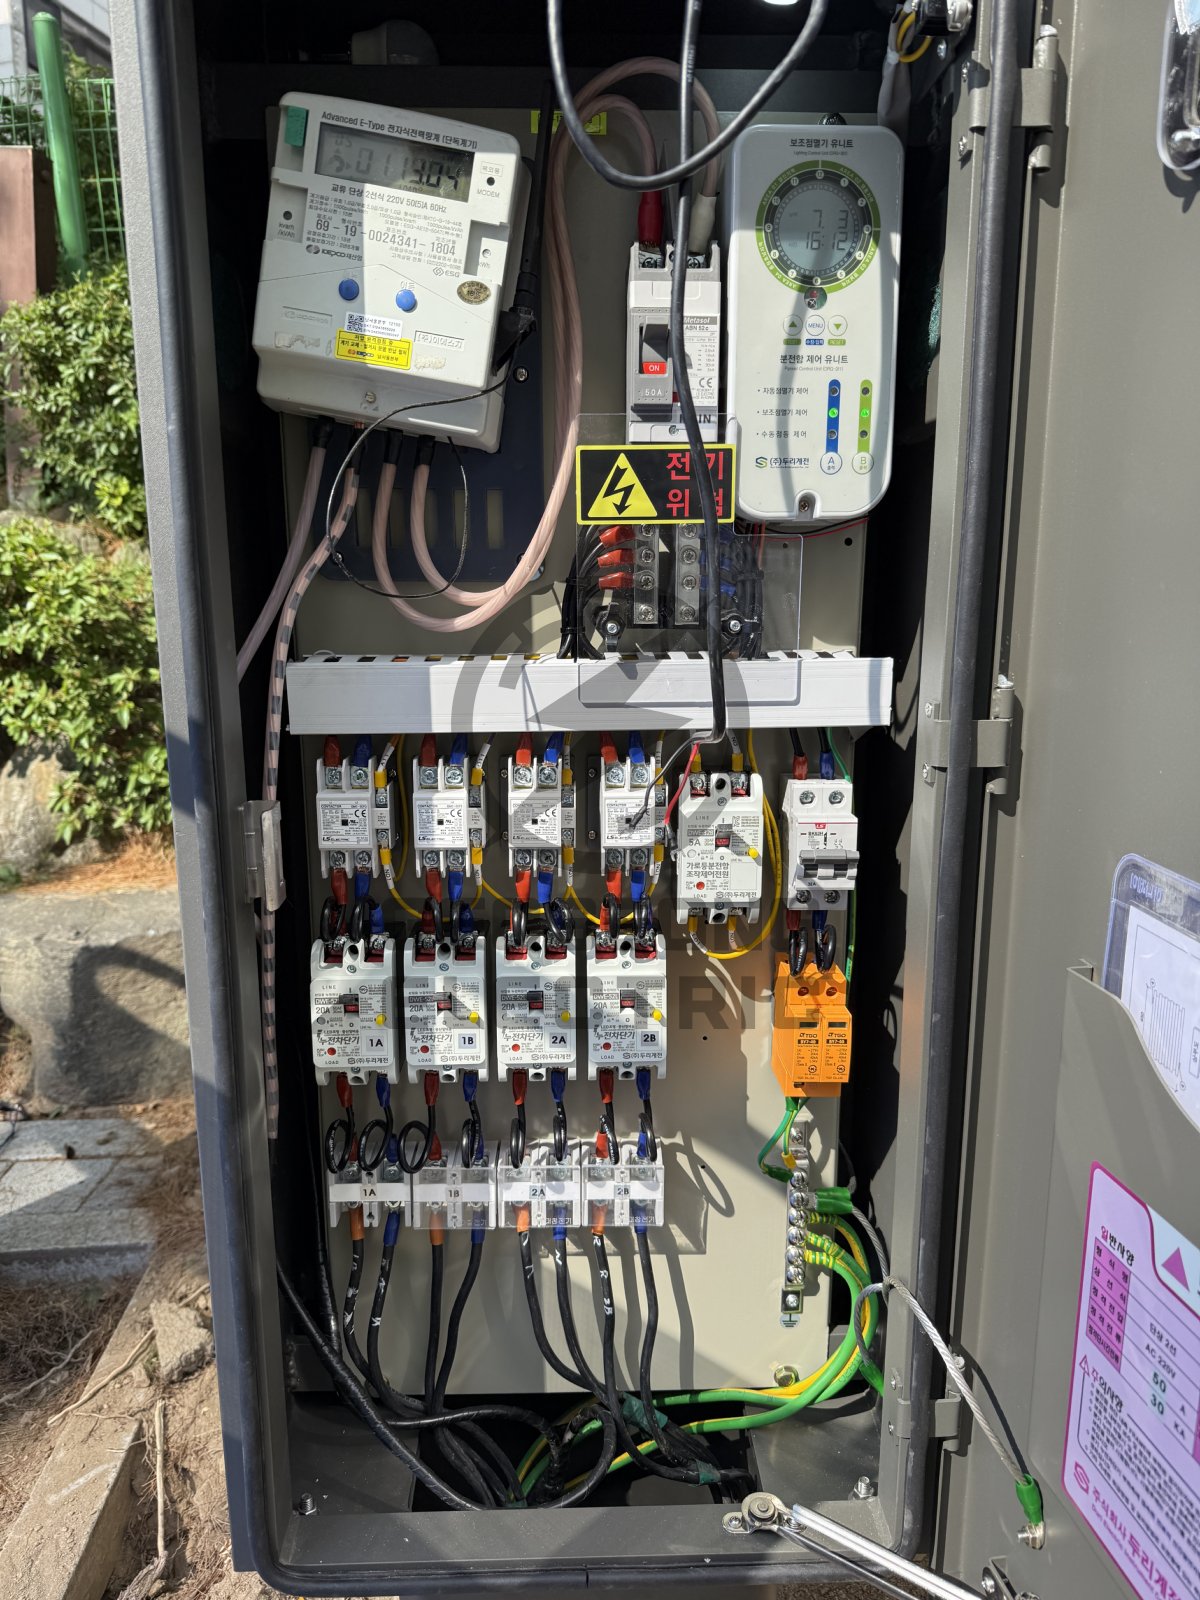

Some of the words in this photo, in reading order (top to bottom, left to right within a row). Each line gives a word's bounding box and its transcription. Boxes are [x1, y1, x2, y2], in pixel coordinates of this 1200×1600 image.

[321, 111, 358, 125] Advanced
[360, 119, 384, 130] E-Type
[388, 124, 440, 142] 전자식전력량계
[790, 139, 828, 148] 보조점멸기
[831, 139, 854, 148] 유니트
[331, 184, 346, 194] 교류
[348, 186, 364, 198] 단상
[366, 190, 385, 202] 2선식
[386, 194, 405, 204] 220V
[316, 219, 330, 232] 69
[344, 225, 357, 237] 19
[368, 230, 417, 248] 0024341
[431, 242, 456, 256] 1804
[806, 232, 848, 250] 16:12
[780, 354, 804, 364] 분전함
[806, 355, 822, 363] 제어
[825, 355, 848, 364] 유니트
[645, 388, 662, 396] 50A
[762, 387, 794, 395] 자동점멸기
[666, 452, 724, 480] 전기
[770, 457, 809, 466] (주)두리계전
[450, 809, 462, 817] CE
[545, 809, 556, 817] CE
[412, 1034, 452, 1043] 누전차단기
[505, 1033, 543, 1041] 누전차단기
[552, 1036, 566, 1044] 2A
[596, 1031, 635, 1040] 누전차단기
[643, 1034, 656, 1042] 2B
[319, 1037, 359, 1045] 누전차단기
[369, 1039, 383, 1047] 1A
[363, 1188, 376, 1196] 1A
[448, 1190, 459, 1198] 1B
[532, 1188, 545, 1197] 2A
[1100, 1223, 1134, 1269] 일반사양
[1145, 1341, 1155, 1360] AC
[1157, 1354, 1175, 1381] 220V
[1091, 1366, 1123, 1416] 주의사항
[1152, 1369, 1166, 1395] 50
[1179, 1401, 1185, 1416] A
[1150, 1391, 1163, 1417] 30
[1173, 1419, 1185, 1440] KA
[1092, 1484, 1126, 1542] 주식회사
